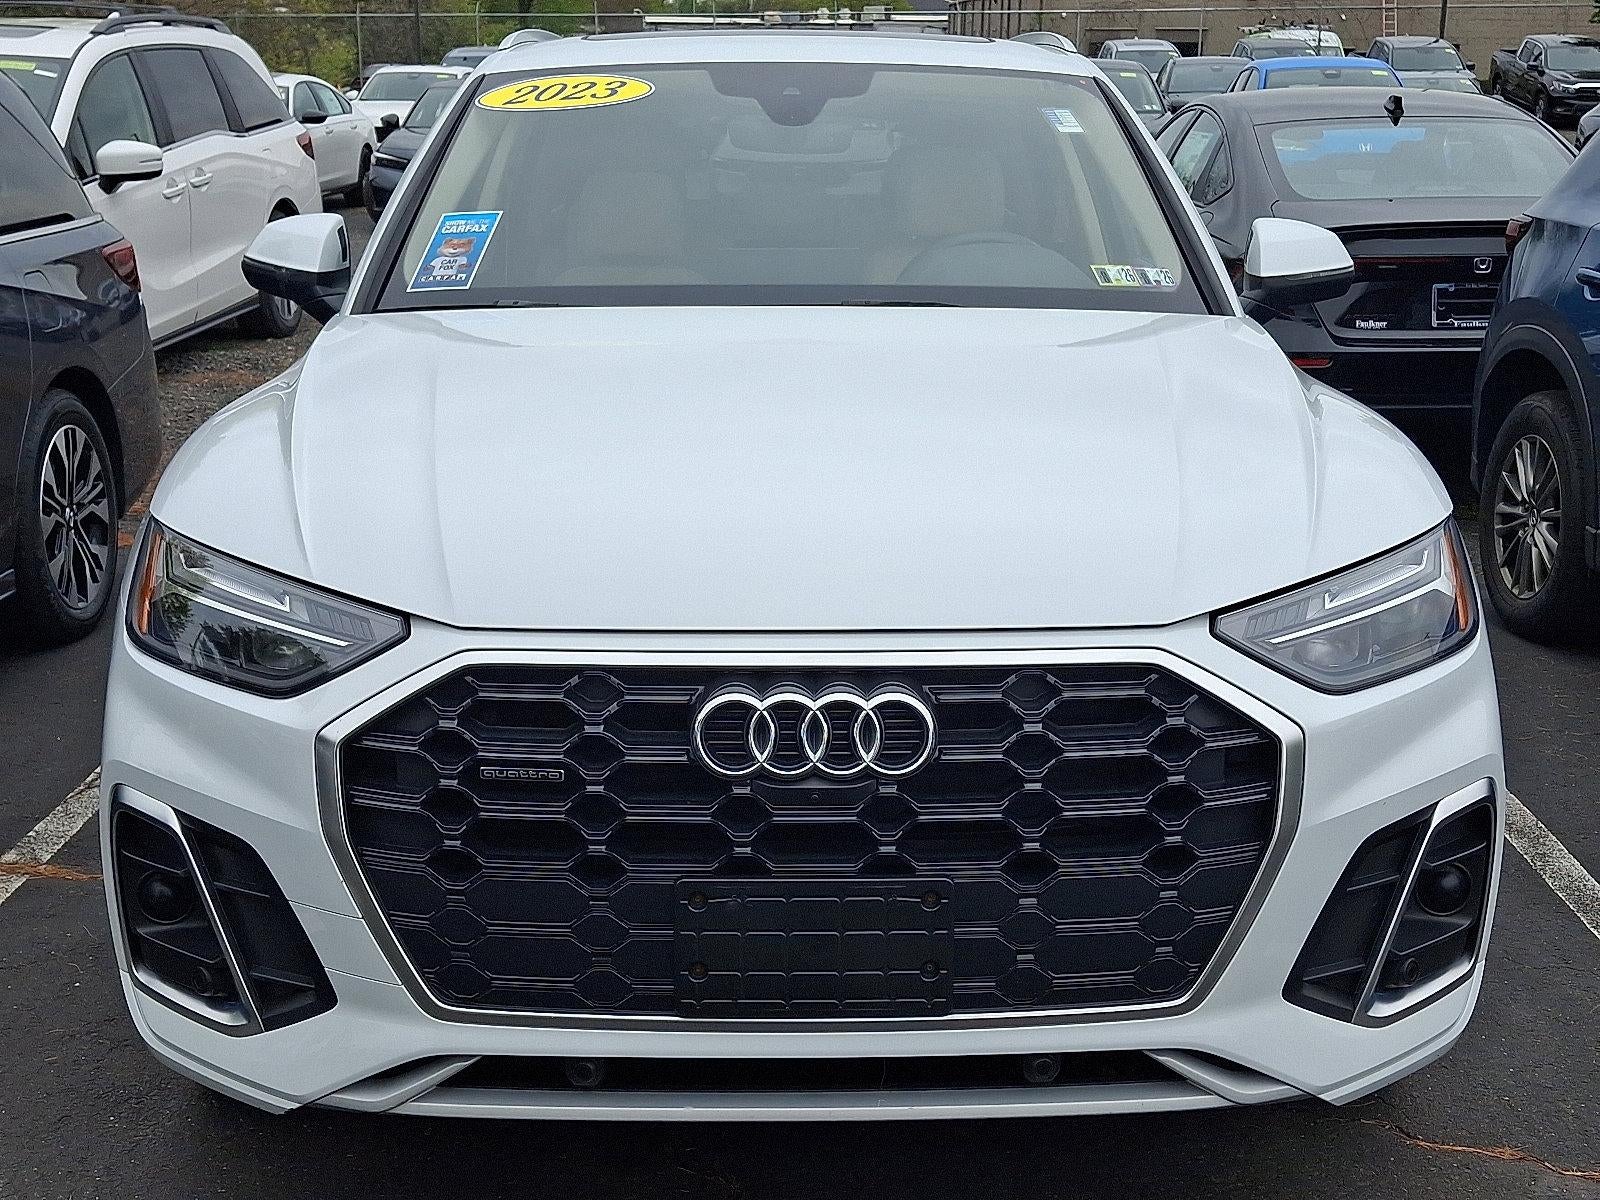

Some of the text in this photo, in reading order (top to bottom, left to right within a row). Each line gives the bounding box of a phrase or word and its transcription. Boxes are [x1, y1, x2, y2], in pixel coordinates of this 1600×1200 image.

[502, 80, 628, 106] 2023
[441, 224, 489, 234] CARFAX
[1454, 320, 1489, 328] Faulkn
[483, 769, 560, 779] quattro
